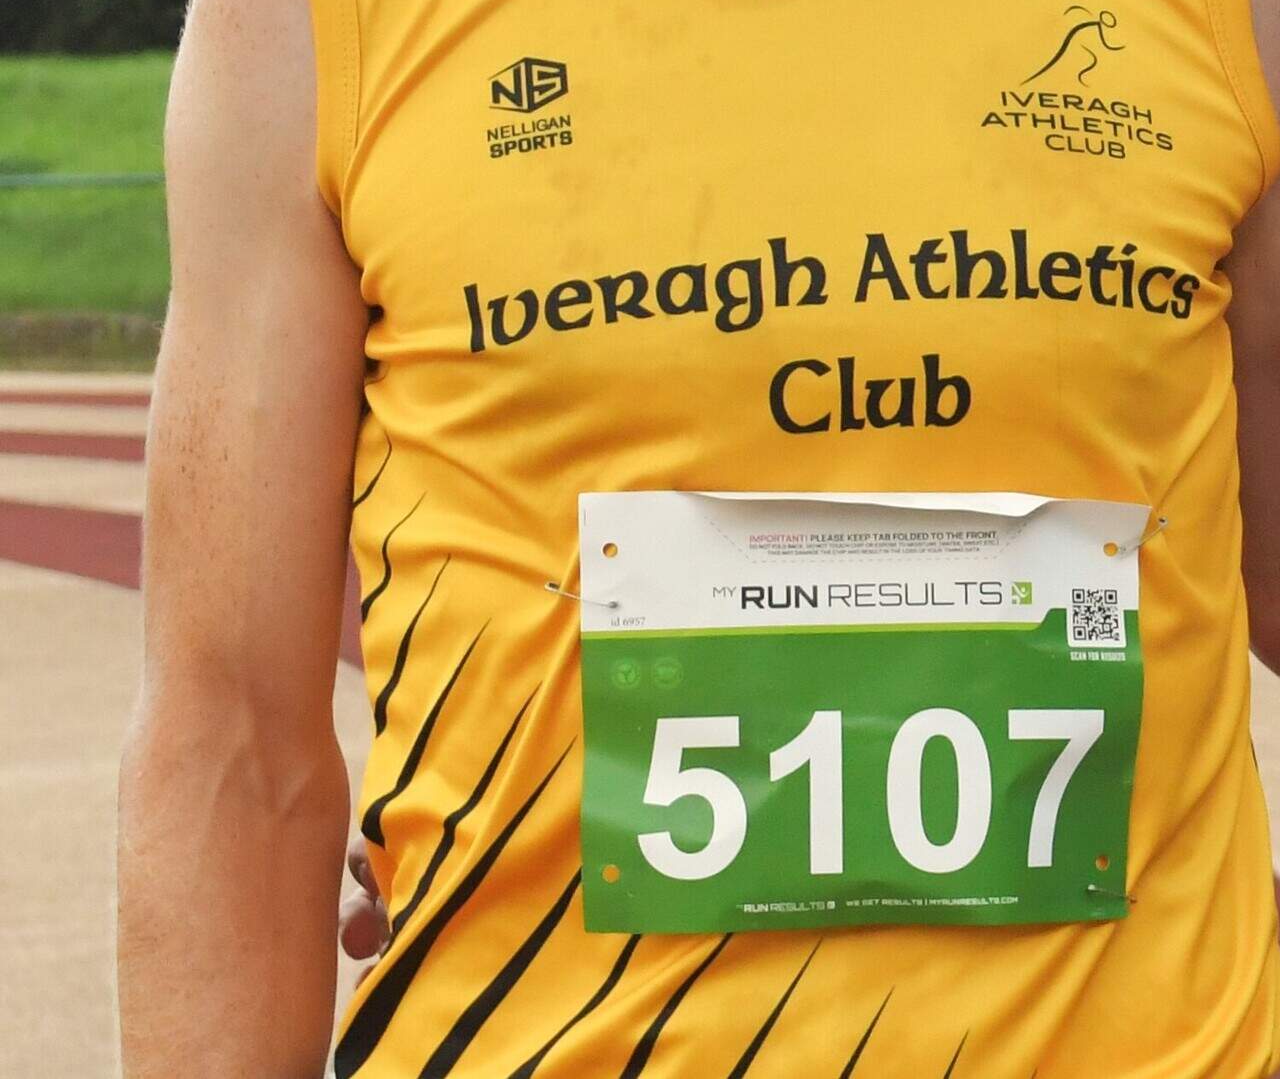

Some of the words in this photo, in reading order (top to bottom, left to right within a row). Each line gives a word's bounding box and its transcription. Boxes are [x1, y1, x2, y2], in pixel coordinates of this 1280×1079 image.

[1001, 91, 1152, 124] IVERAGH
[487, 114, 571, 142] NELLIGAN
[981, 112, 1173, 151] ATHLETICS
[490, 131, 573, 158] SPORTS
[1045, 134, 1126, 159] CLUB
[463, 236, 826, 352] Iveragh
[855, 229, 1200, 320] Athletics
[769, 354, 971, 435] Club
[810, 534, 844, 542] PLEASE
[847, 533, 870, 541] KEEP
[872, 533, 891, 541] TAB
[893, 532, 928, 541] FOLDED
[931, 532, 943, 540] TO
[945, 531, 963, 539] THE
[966, 531, 997, 539] FRONT
[713, 586, 736, 598] MY
[741, 585, 818, 609] RUN
[828, 581, 1002, 607] RESULTS
[637, 707, 1105, 880] 5107
[744, 903, 769, 912] RUN
[770, 901, 825, 912] RESULTS
